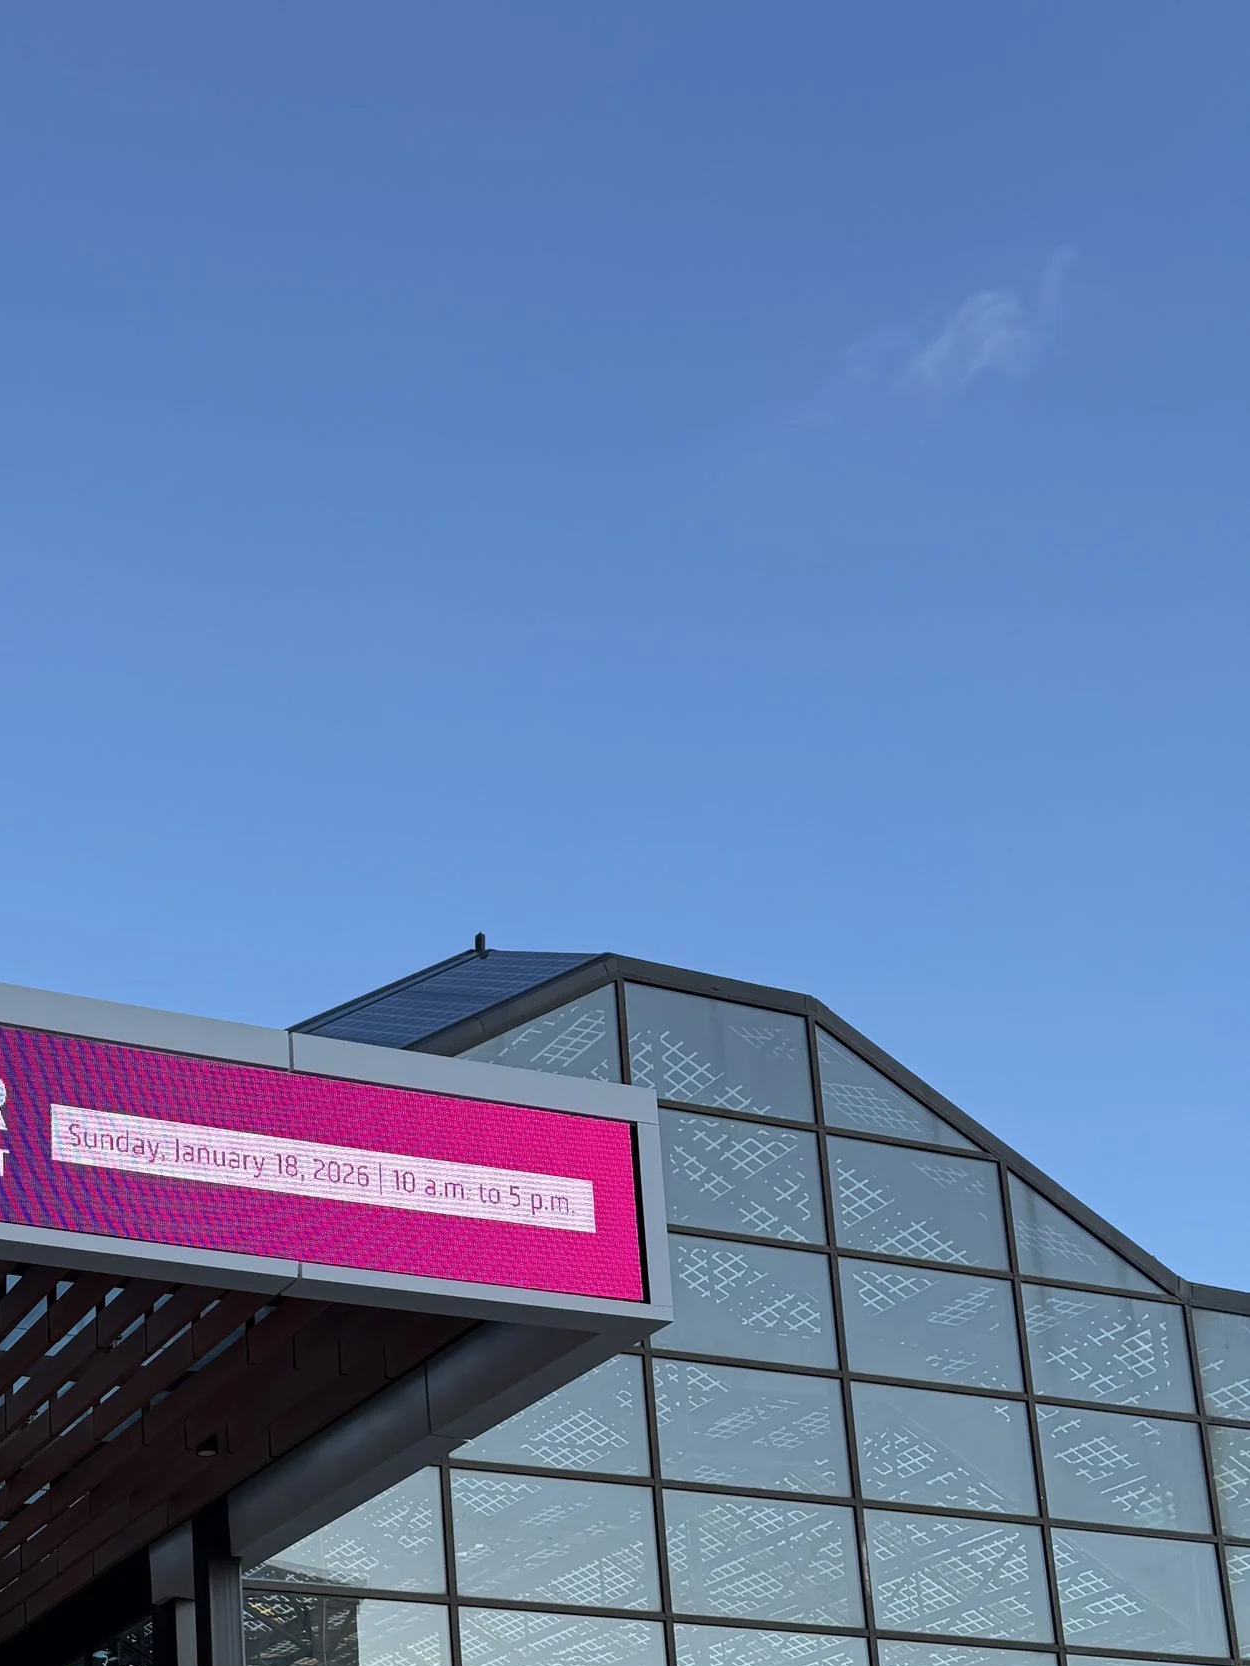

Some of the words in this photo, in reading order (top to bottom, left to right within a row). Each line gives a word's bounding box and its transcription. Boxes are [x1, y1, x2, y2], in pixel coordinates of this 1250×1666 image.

[68, 1123, 166, 1163] Sunday,
[173, 1138, 265, 1178] January
[275, 1153, 305, 1182] 18,
[313, 1158, 370, 1188] 2026
[392, 1169, 416, 1194] 10
[479, 1183, 501, 1205] to
[509, 1185, 521, 1207] 5
[531, 1193, 576, 1216] p.m.
